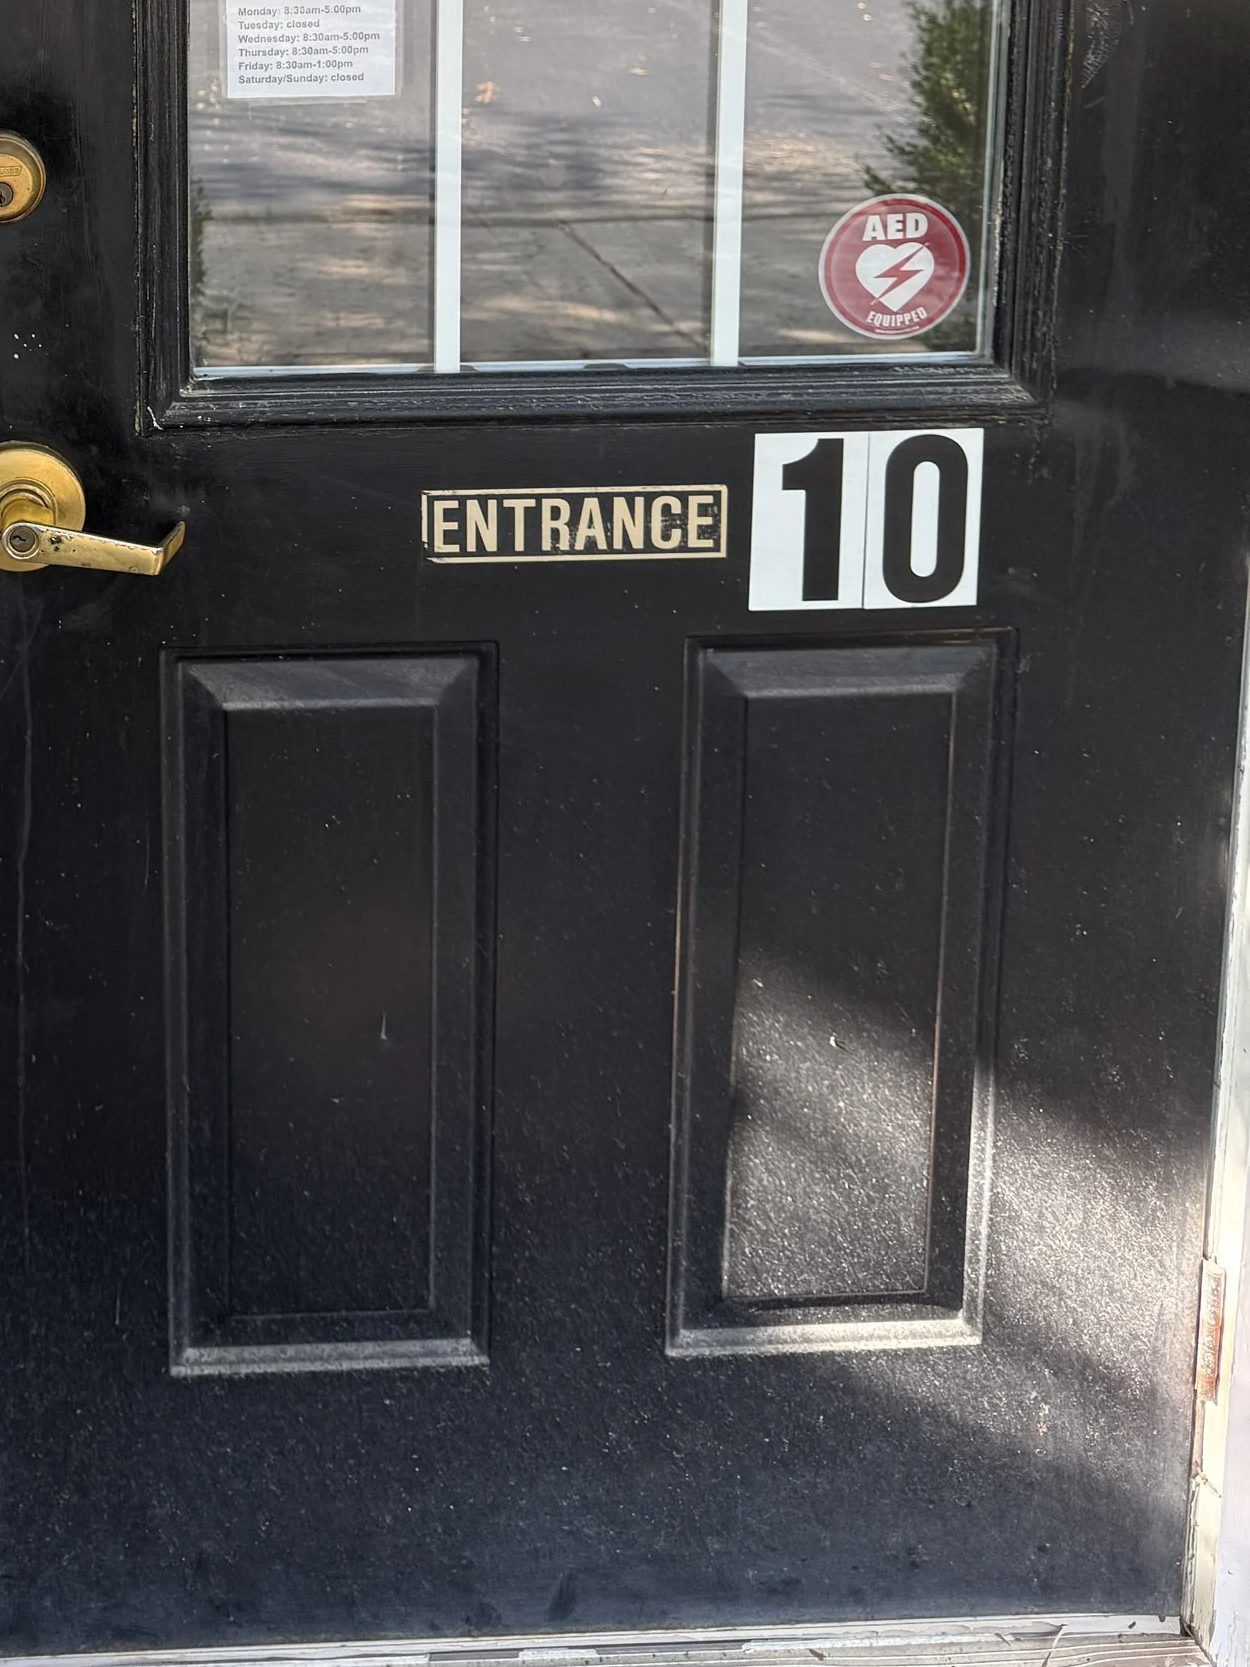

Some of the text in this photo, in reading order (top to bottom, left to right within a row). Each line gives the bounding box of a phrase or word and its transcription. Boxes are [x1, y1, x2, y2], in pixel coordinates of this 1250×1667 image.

[238, 5, 361, 17] Monday: 8:30am-5:00pm
[238, 19, 320, 31] Tuesday: closed
[238, 32, 380, 44] Wednesday: 8:30am-5:00pm
[238, 45, 369, 58] Thursday: 8:30am-5:00pm
[238, 59, 353, 71] Friday: 8:30am-1:00pm
[238, 73, 364, 85] Saturday/Sunday: closed
[862, 212, 928, 241] AED
[866, 306, 928, 327] EQUIPPED
[433, 495, 715, 553] ENTRANCE
[781, 434, 969, 604] 10
